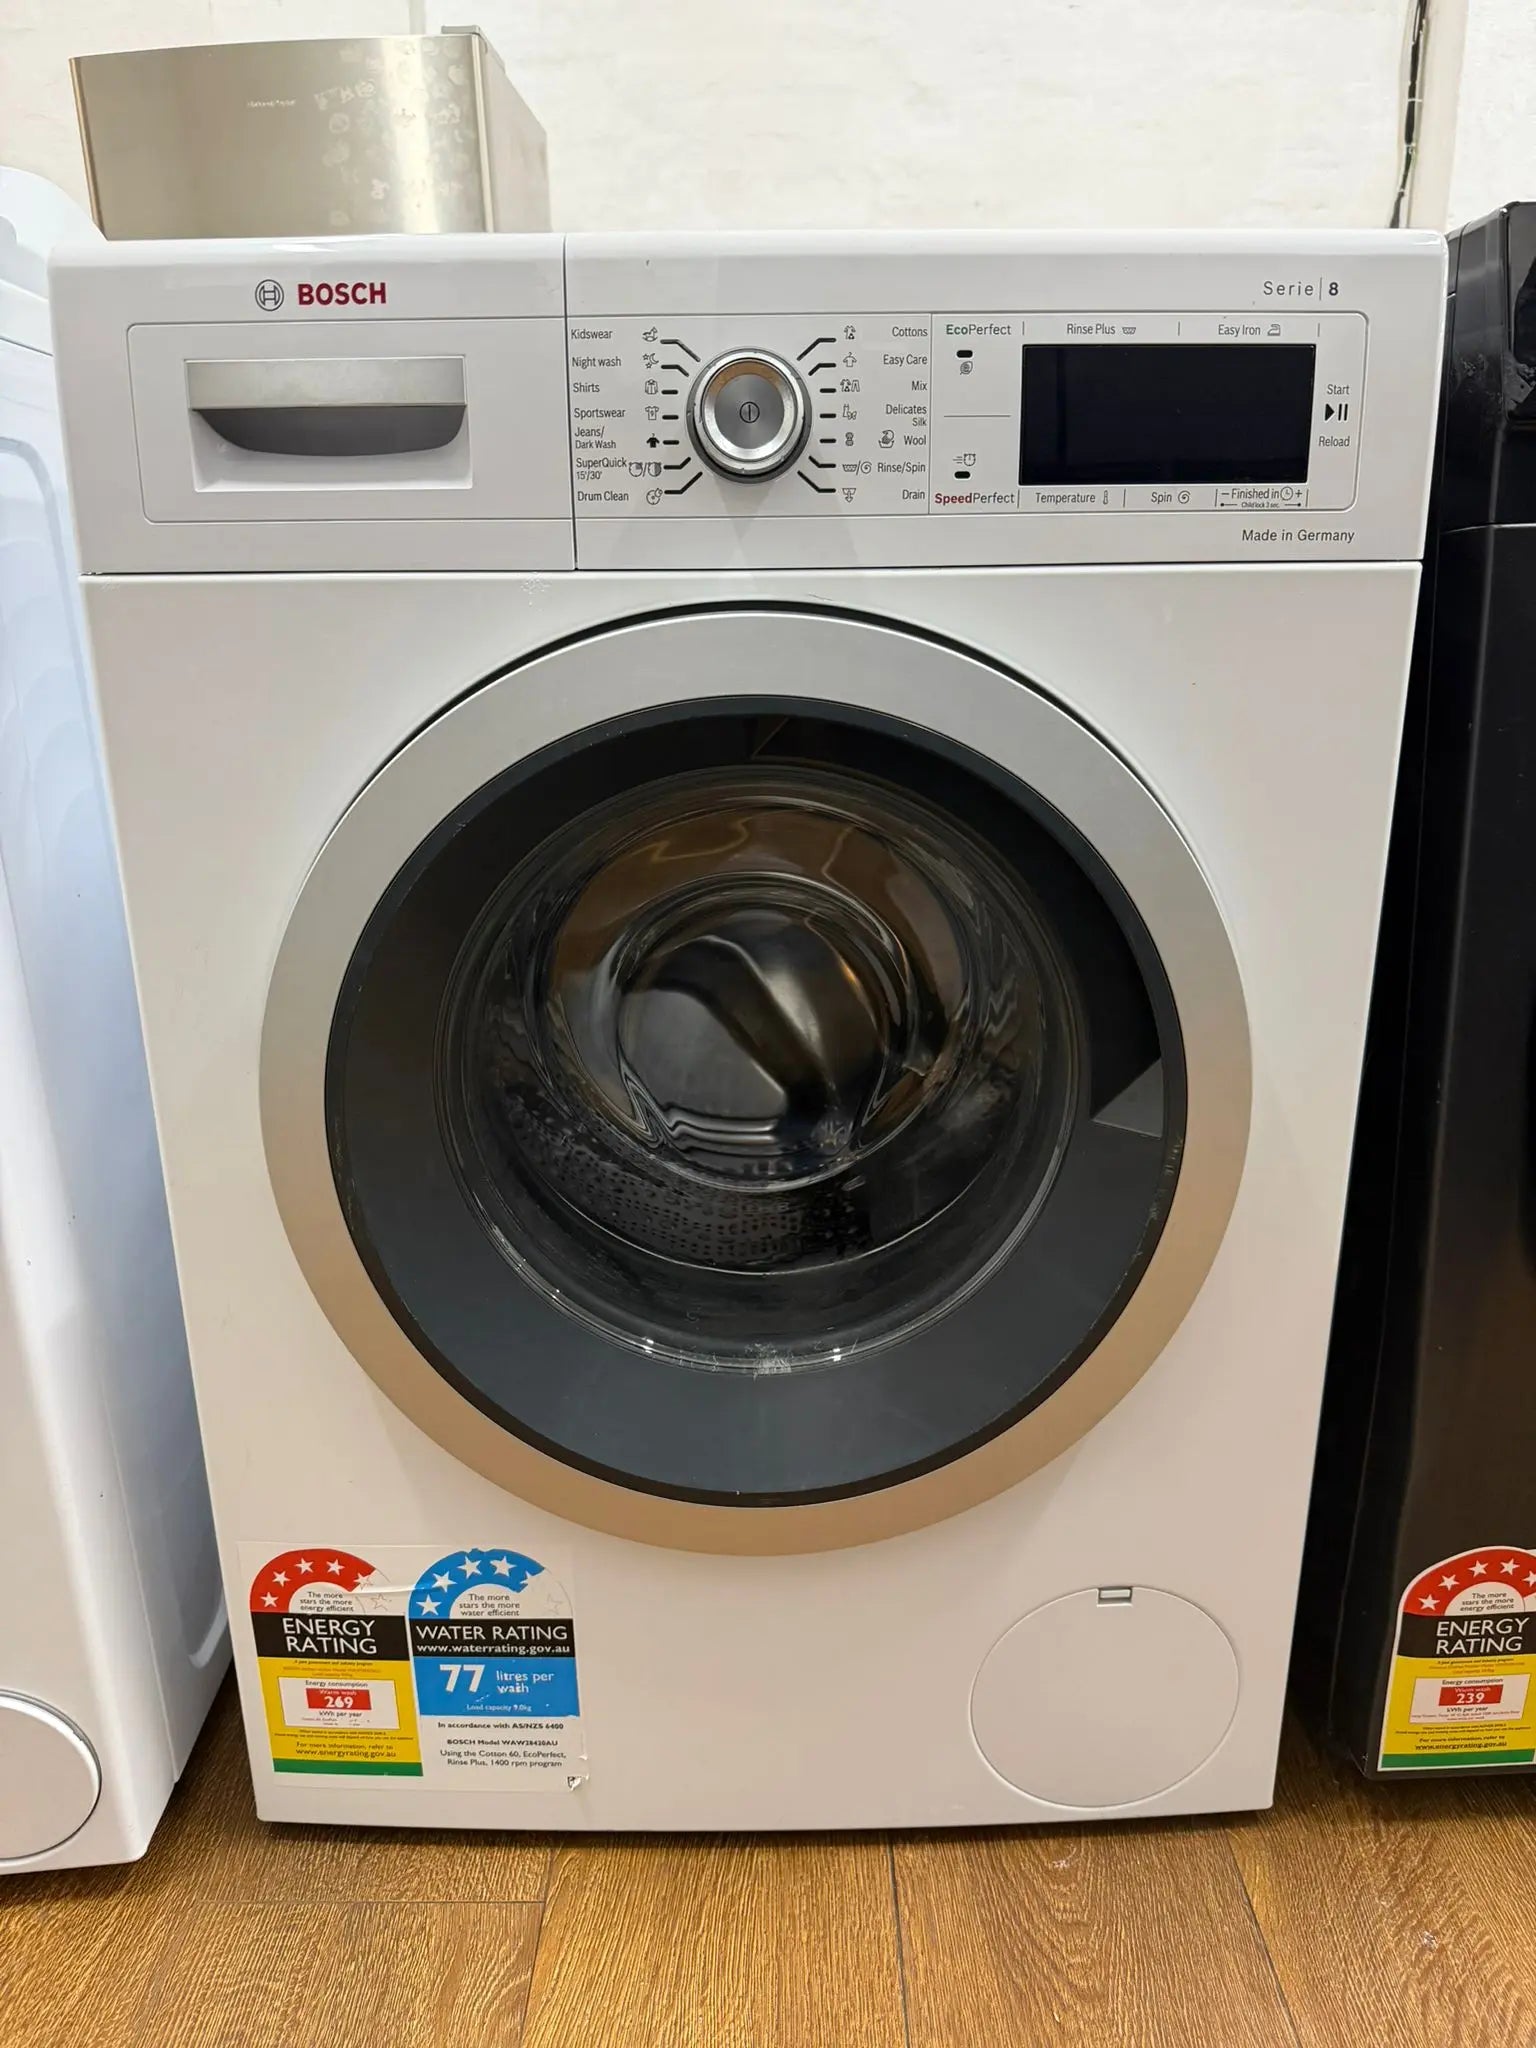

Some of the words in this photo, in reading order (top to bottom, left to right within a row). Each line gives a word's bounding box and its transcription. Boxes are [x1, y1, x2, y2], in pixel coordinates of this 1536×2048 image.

[298, 282, 387, 306] BOSCH
[1263, 281, 1314, 296] Serie
[1328, 282, 1339, 296] 8
[571, 329, 613, 339] Kidswear
[892, 326, 928, 337] Cottons
[946, 324, 1011, 335] EcoPerfect
[1067, 323, 1093, 335] Rinse
[1095, 323, 1116, 335] Plus
[1218, 324, 1240, 337] Easy
[1242, 324, 1261, 336] Iron
[572, 357, 596, 369] Night
[598, 356, 621, 367] wash
[883, 354, 904, 367] Easy
[906, 354, 928, 365] Care
[573, 382, 600, 393] Shirts
[911, 380, 928, 391] Mix
[1327, 384, 1350, 395] Start
[574, 408, 626, 420] Sportswear
[885, 404, 927, 415] Delicates
[912, 418, 927, 427] Silk
[574, 426, 605, 438] Jeans/
[575, 440, 593, 449] Dark
[596, 440, 616, 449] Wash
[904, 435, 926, 446] Wool
[1318, 436, 1350, 448] Reload
[576, 457, 627, 470] SuperQuick
[877, 461, 926, 474] Rinse/Spin
[577, 491, 602, 501] Drum
[604, 491, 629, 501] Clean
[902, 489, 925, 500] Drain
[935, 492, 1015, 505] SpeedPerfect
[1036, 492, 1096, 505] Temperature
[1151, 492, 1172, 505] Spin
[1232, 488, 1270, 499] Finished
[1271, 488, 1280, 499] in
[1242, 530, 1278, 541] Made
[1281, 530, 1293, 541] in
[1297, 530, 1355, 544] Germany
[469, 1593, 484, 1601] The
[282, 1617, 375, 1637] ENERGY
[416, 1625, 486, 1640] WATER
[493, 1625, 568, 1640] RATING
[1436, 1617, 1530, 1637] ENERGY
[286, 1636, 377, 1655] RATING
[417, 1643, 570, 1655] www.waterrating.gov.au
[1435, 1636, 1523, 1655] RATING
[439, 1664, 486, 1693] 77
[496, 1670, 528, 1681] litres
[533, 1673, 554, 1684] per
[324, 1696, 354, 1708] 269
[1456, 1692, 1485, 1704] 239
[440, 1750, 462, 1758] Using
[530, 1760, 562, 1768] program
